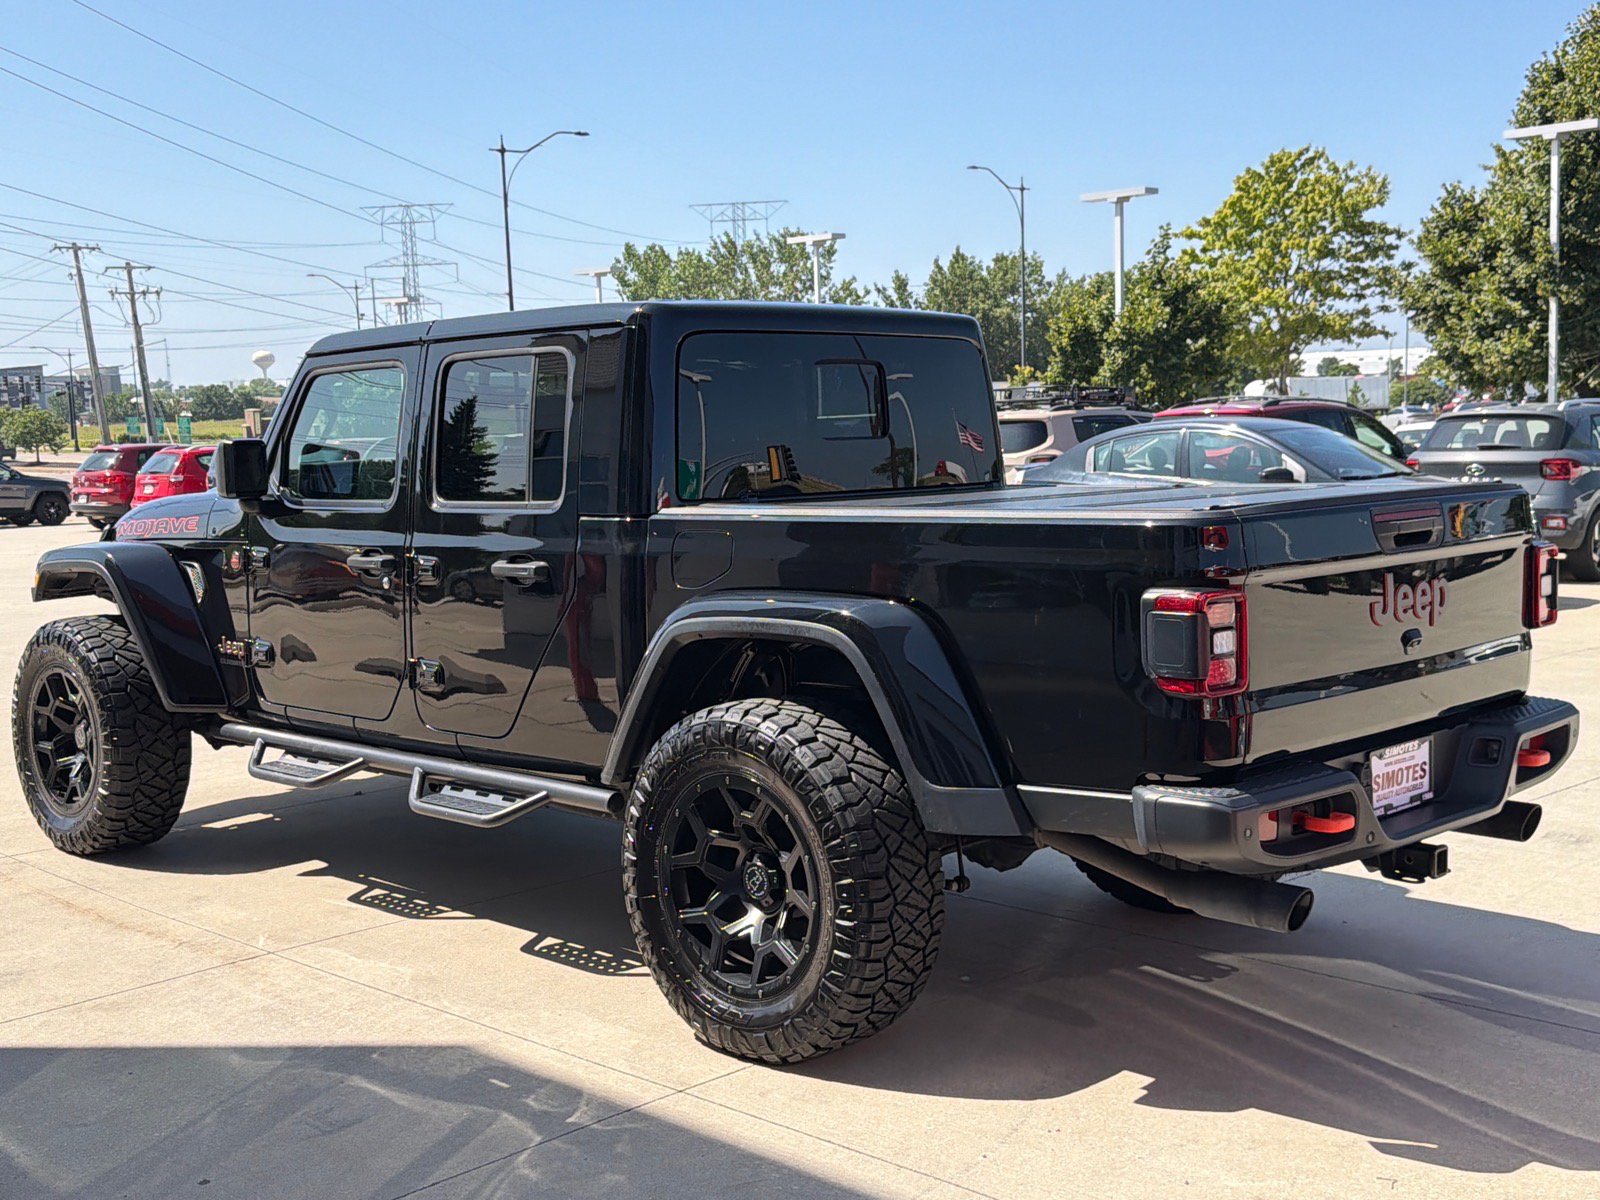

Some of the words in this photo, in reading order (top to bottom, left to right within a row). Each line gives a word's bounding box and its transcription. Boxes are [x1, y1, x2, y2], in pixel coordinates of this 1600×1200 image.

[116, 516, 199, 538] MOJAVE
[1369, 572, 1447, 627] Jeep
[218, 635, 245, 659] Jeep
[1384, 740, 1420, 758] SIMOTES
[1373, 761, 1427, 793] SIMOTES
